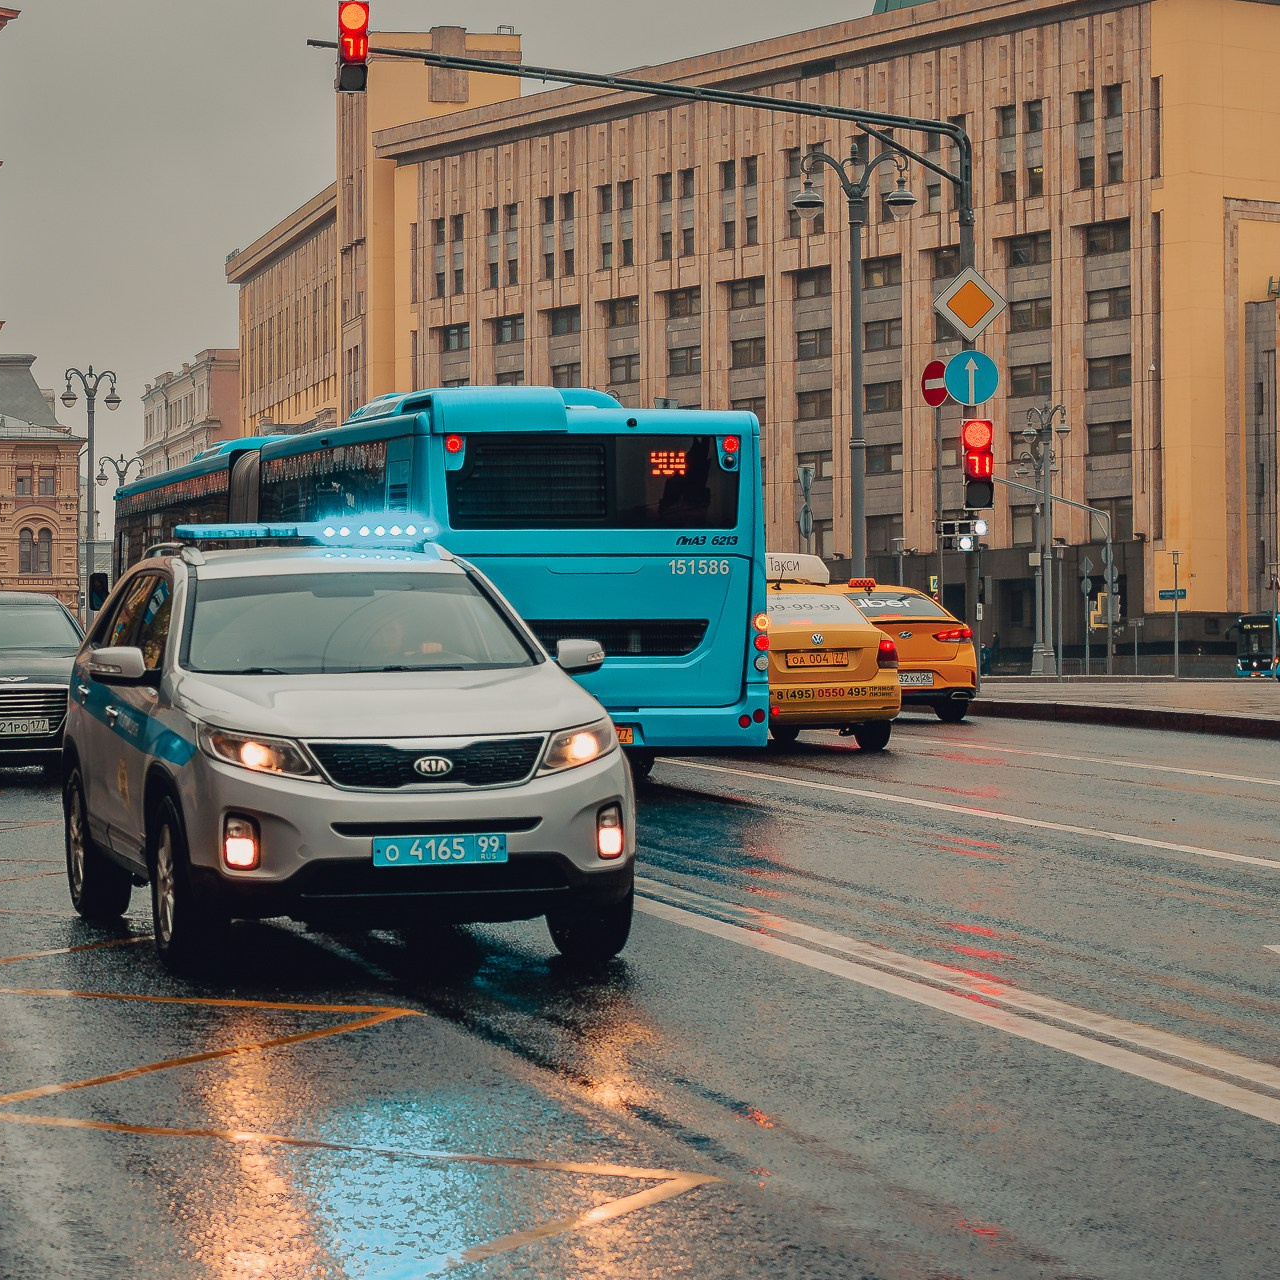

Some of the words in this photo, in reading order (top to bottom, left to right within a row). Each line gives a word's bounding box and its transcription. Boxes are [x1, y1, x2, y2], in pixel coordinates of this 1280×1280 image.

[344, 38, 364, 56] 71
[969, 456, 989, 474] 71
[711, 535, 738, 546] 6213
[668, 559, 730, 575] 151586
[768, 557, 800, 572] Такси
[809, 653, 829, 664] 004
[776, 691, 784, 700] 8
[786, 688, 815, 701] (495)
[817, 688, 845, 698] 0550
[847, 687, 867, 697] 495
[29, 719, 45, 730] 177
[420, 760, 447, 772] KIA
[409, 837, 465, 861] 4165
[477, 835, 500, 853] 99
